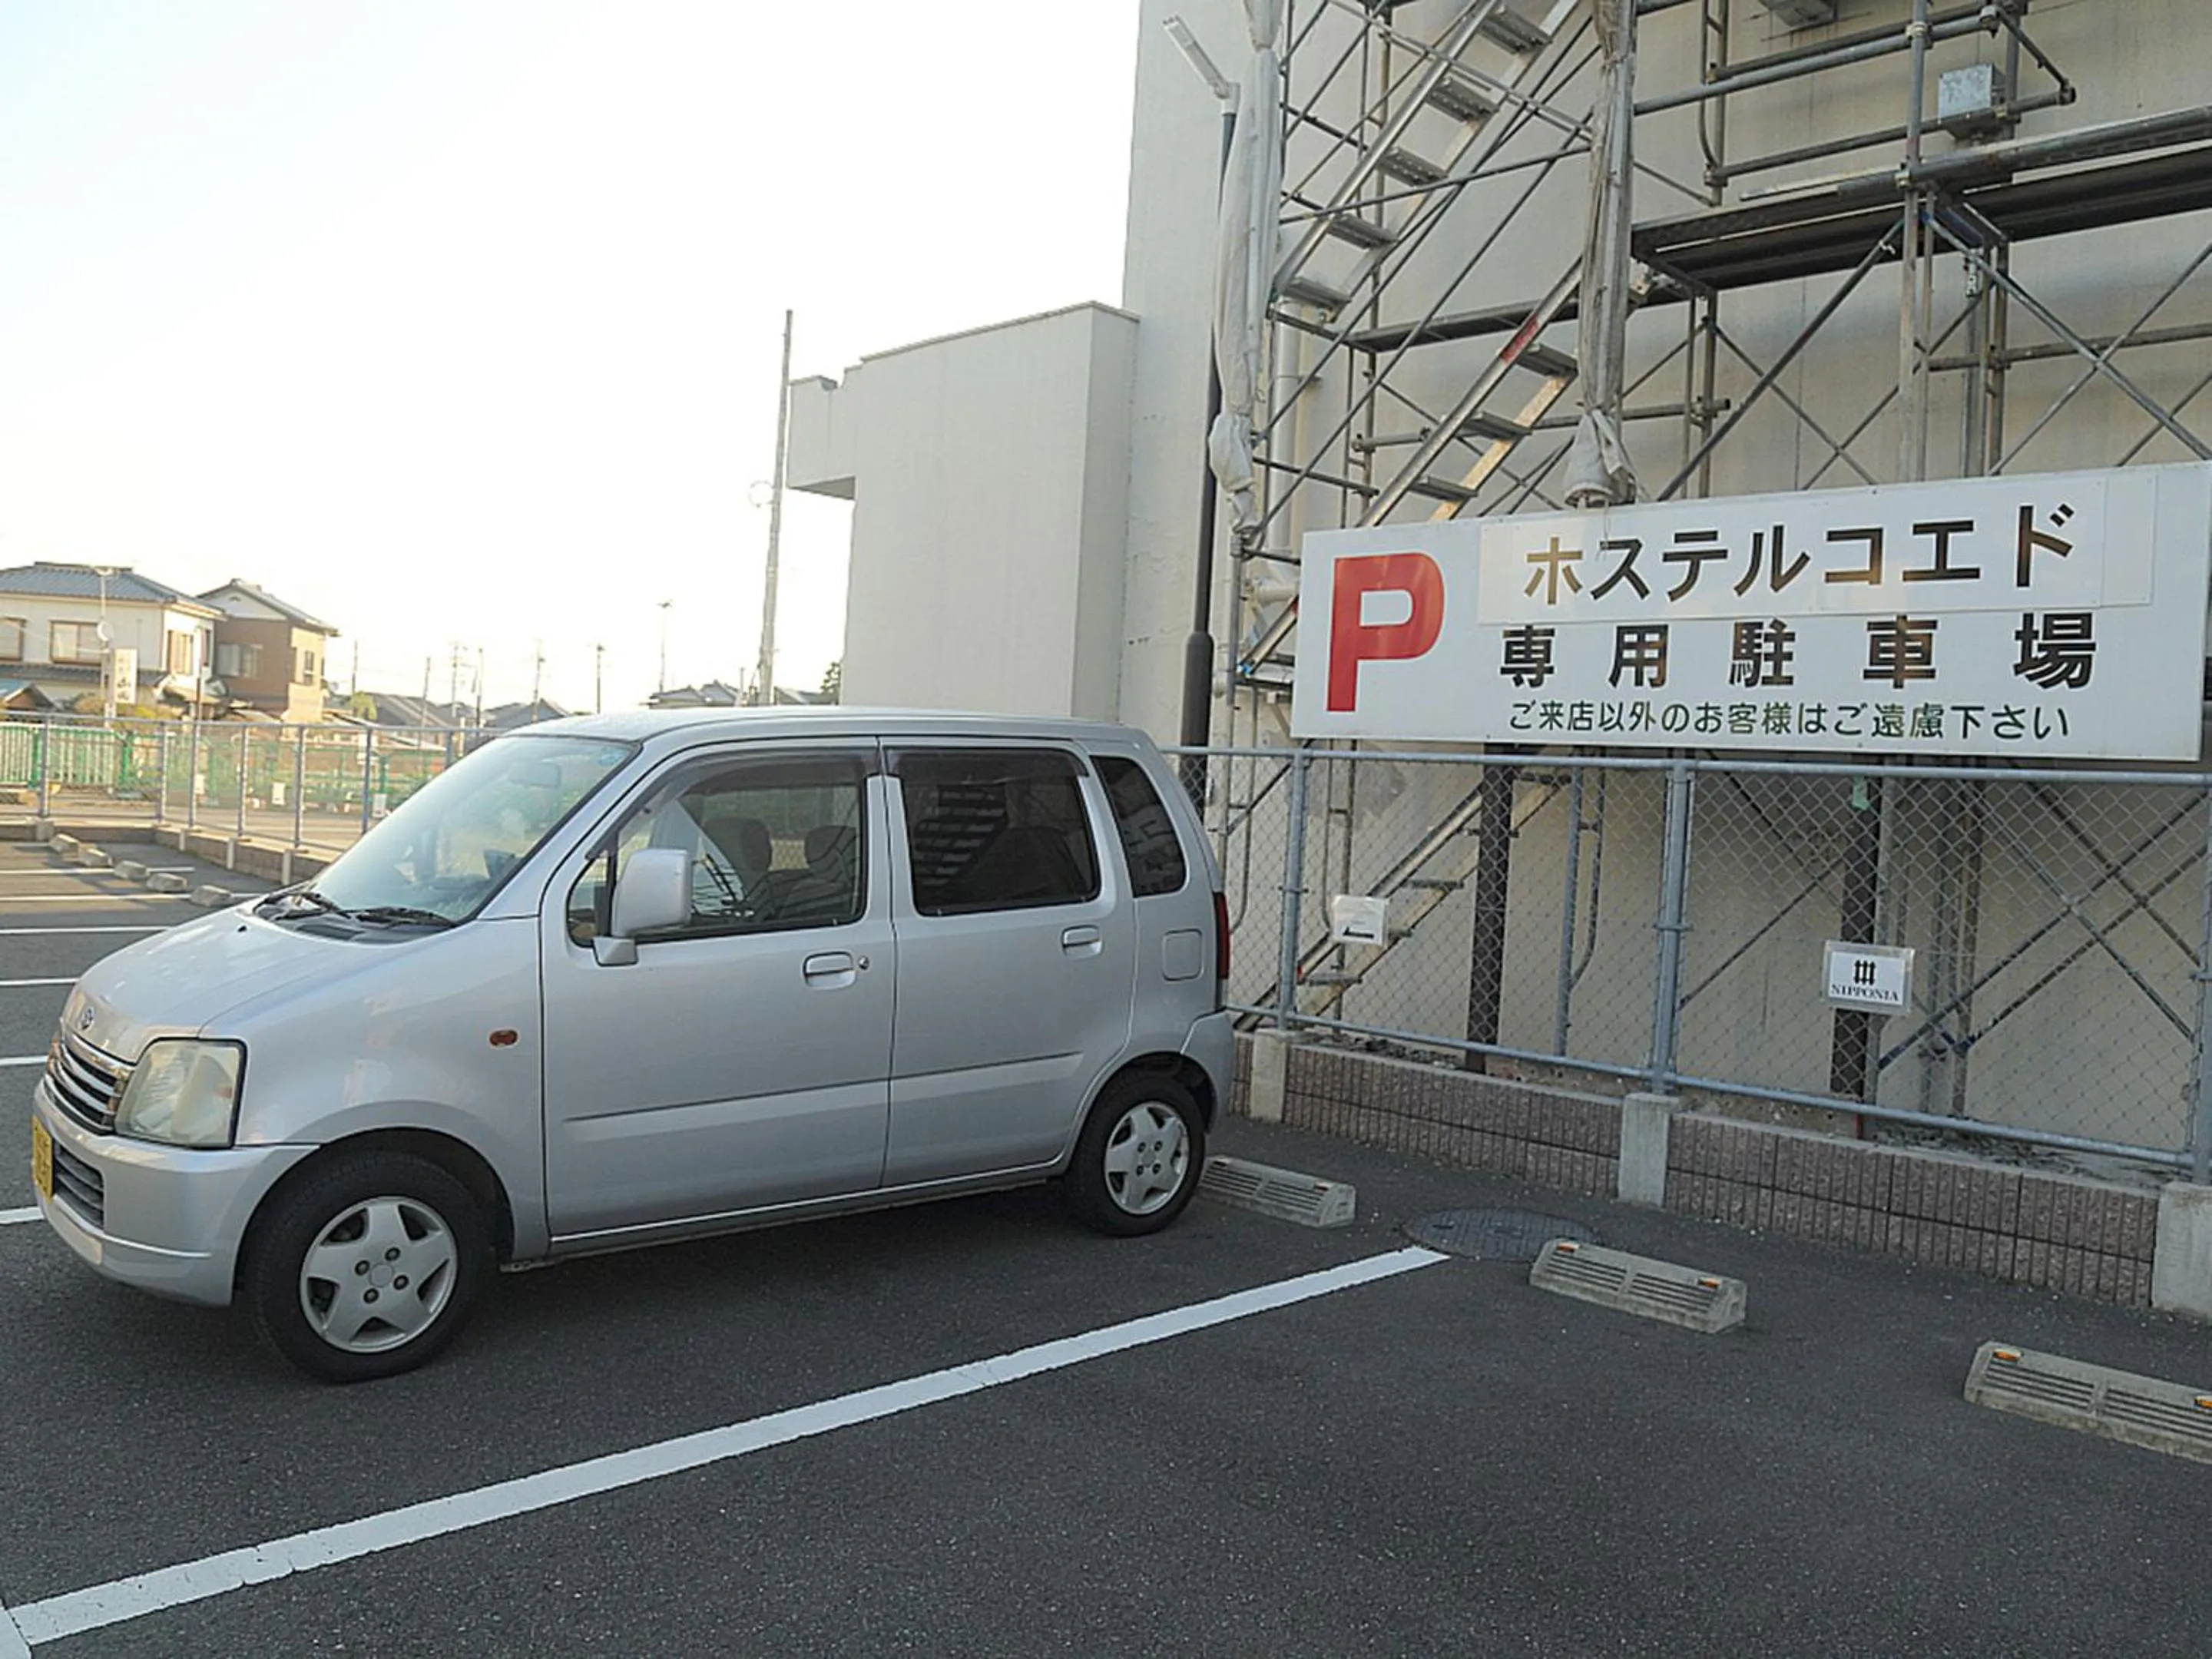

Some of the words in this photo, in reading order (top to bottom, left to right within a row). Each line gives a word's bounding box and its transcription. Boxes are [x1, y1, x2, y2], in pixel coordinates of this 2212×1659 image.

[1525, 504, 2075, 606] ホステルコエド
[1327, 552, 1444, 711] P
[1499, 612, 2097, 690] 専用駐車場
[1509, 700, 2068, 740] ご来店以外のお客様はご遠慮下さい
[1831, 984, 1899, 1002] NIPPONIA
